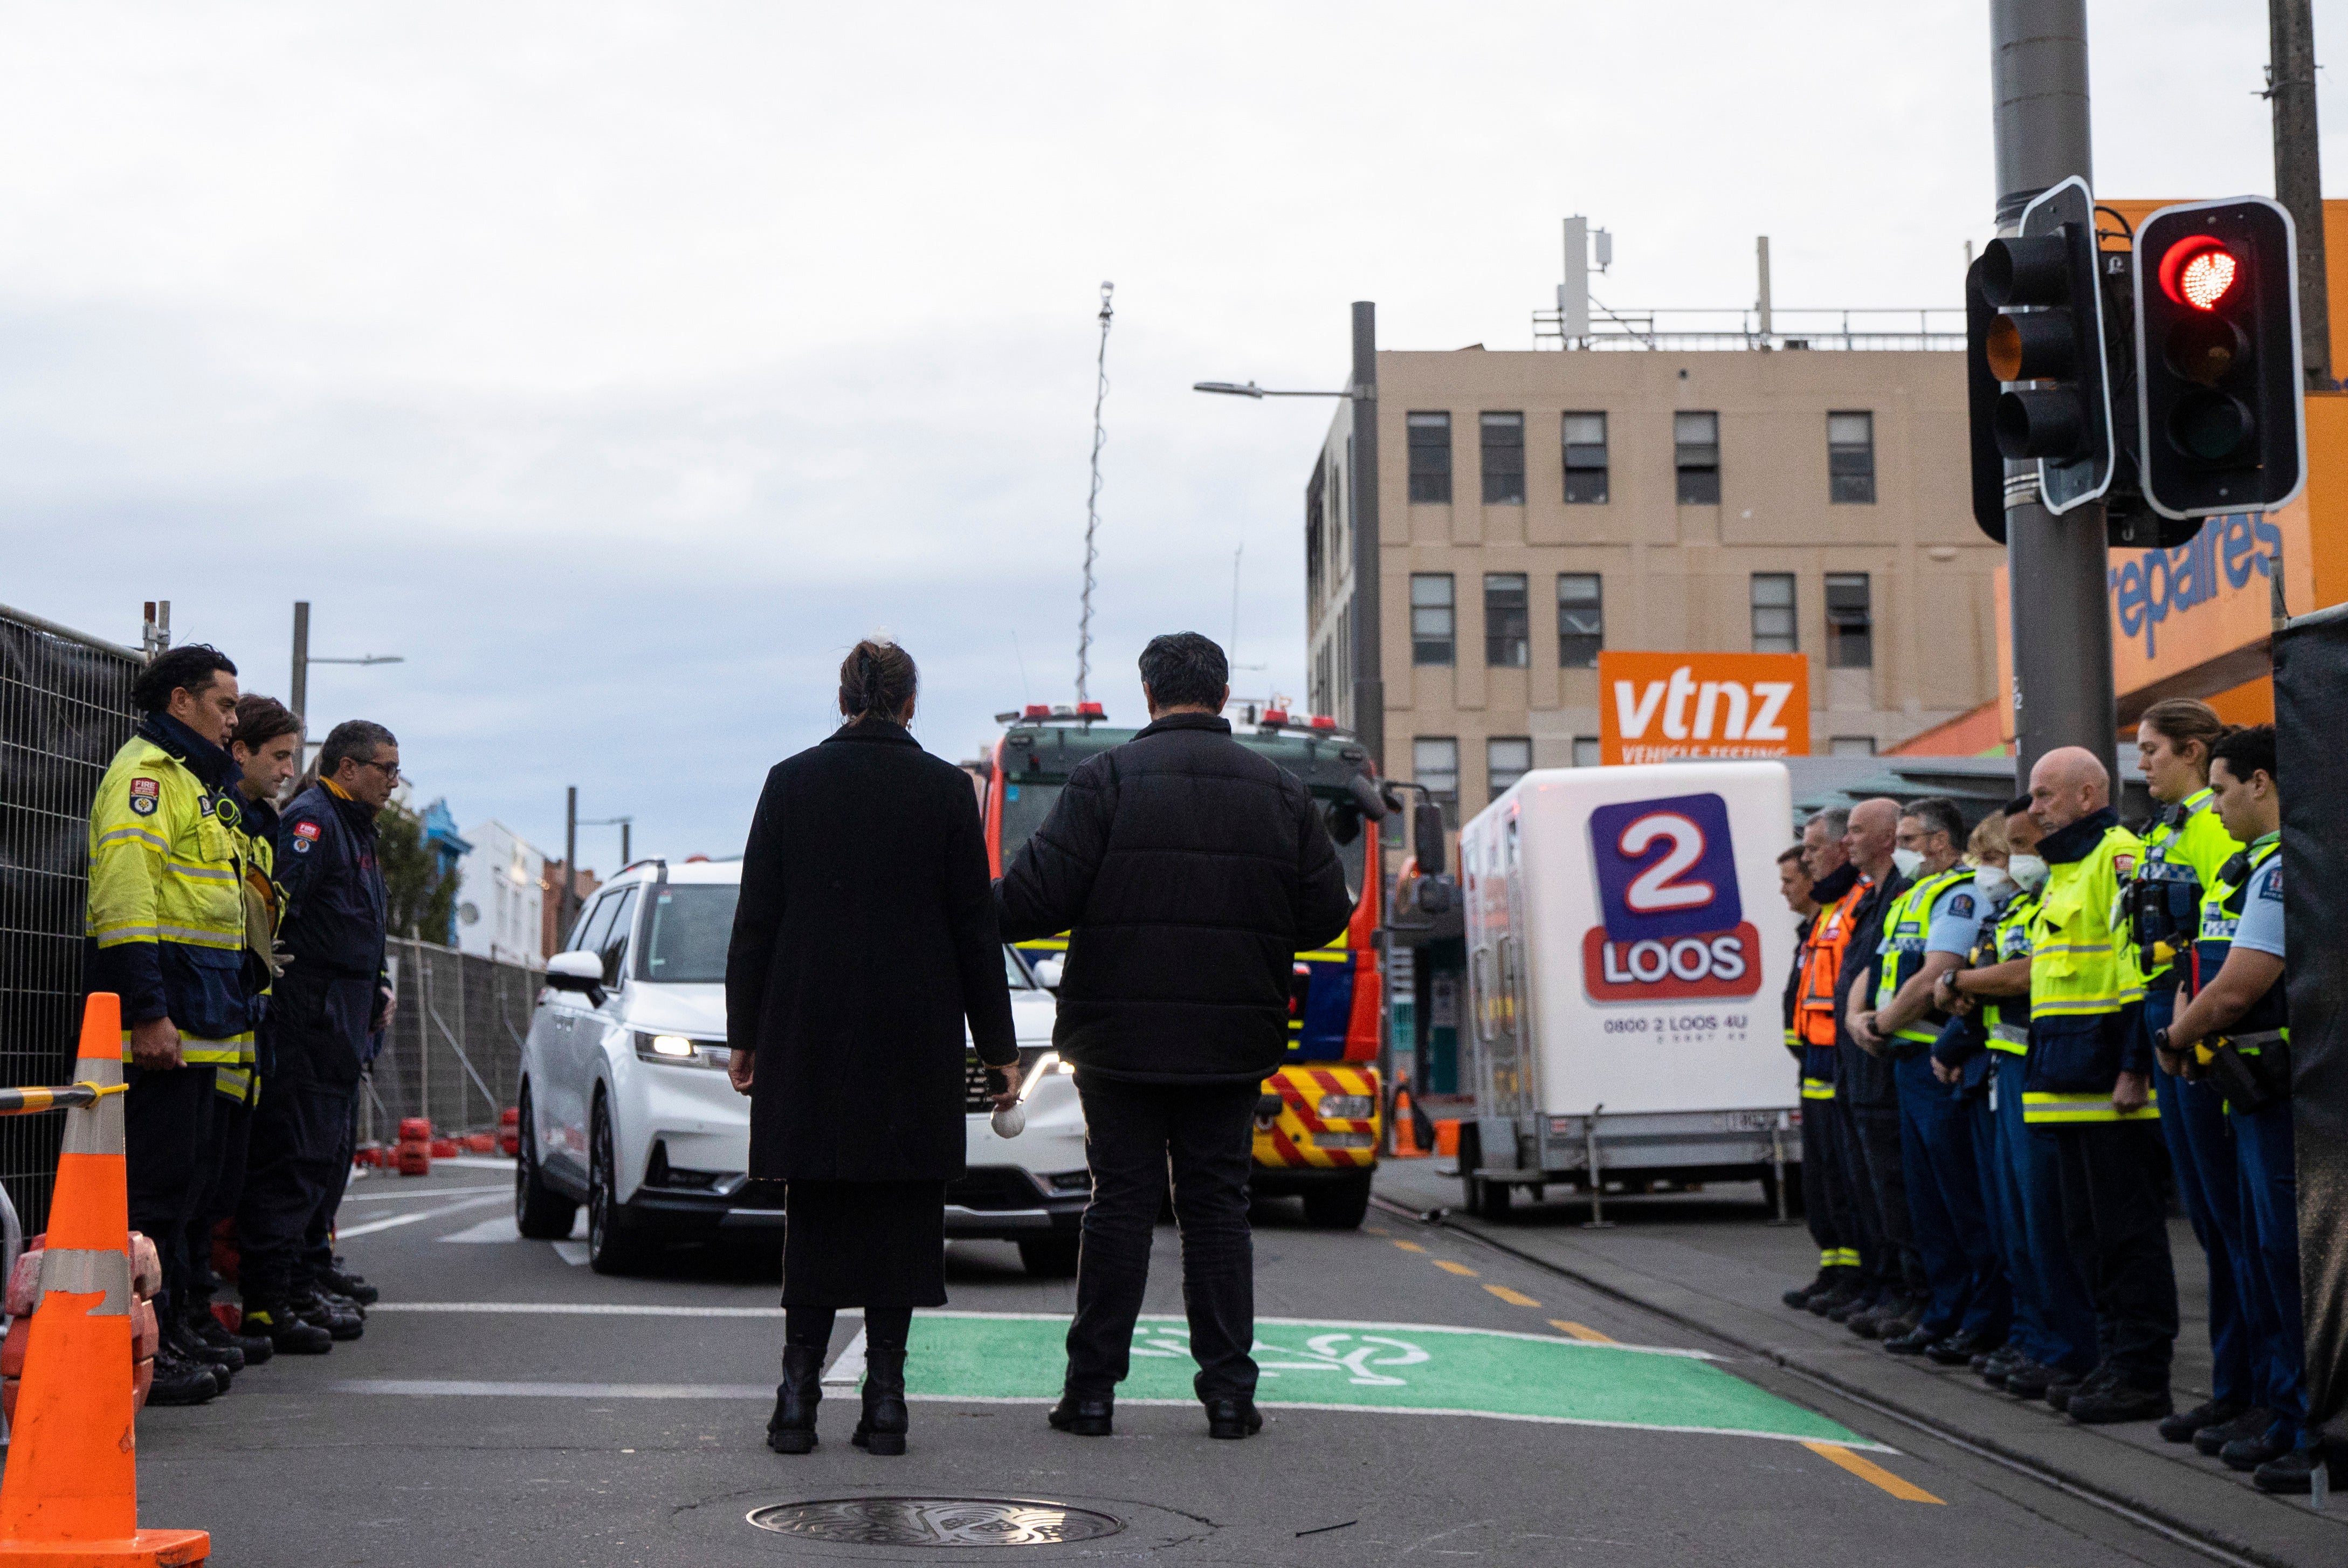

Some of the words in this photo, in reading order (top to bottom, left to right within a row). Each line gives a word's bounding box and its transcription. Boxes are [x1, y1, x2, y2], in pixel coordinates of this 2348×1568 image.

[1614, 665, 1794, 740] vtnz
[1619, 810, 1716, 913] 2
[1603, 936, 1746, 983] LOOS
[1605, 1019, 1647, 1033] 0800
[1654, 1017, 1663, 1032] 2
[1669, 1015, 1718, 1031] LOOS
